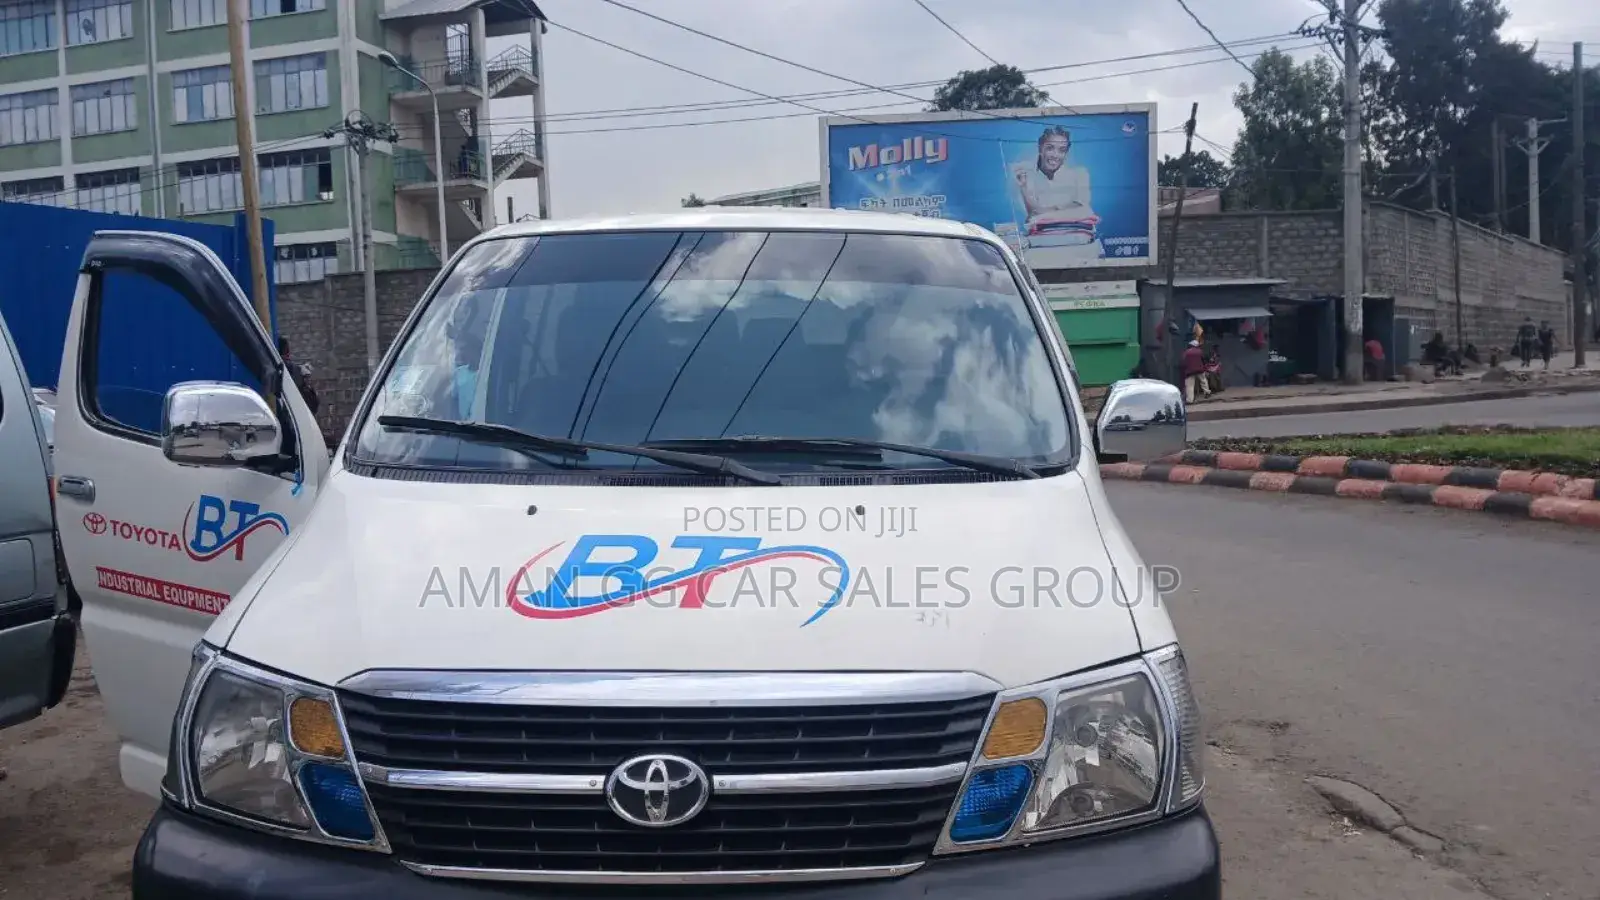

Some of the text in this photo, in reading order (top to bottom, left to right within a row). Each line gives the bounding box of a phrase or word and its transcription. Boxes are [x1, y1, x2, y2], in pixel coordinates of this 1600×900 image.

[848, 135, 948, 171] Molly
[109, 519, 182, 551] TOYOTA
[190, 494, 261, 561] BT
[525, 534, 762, 609] BT
